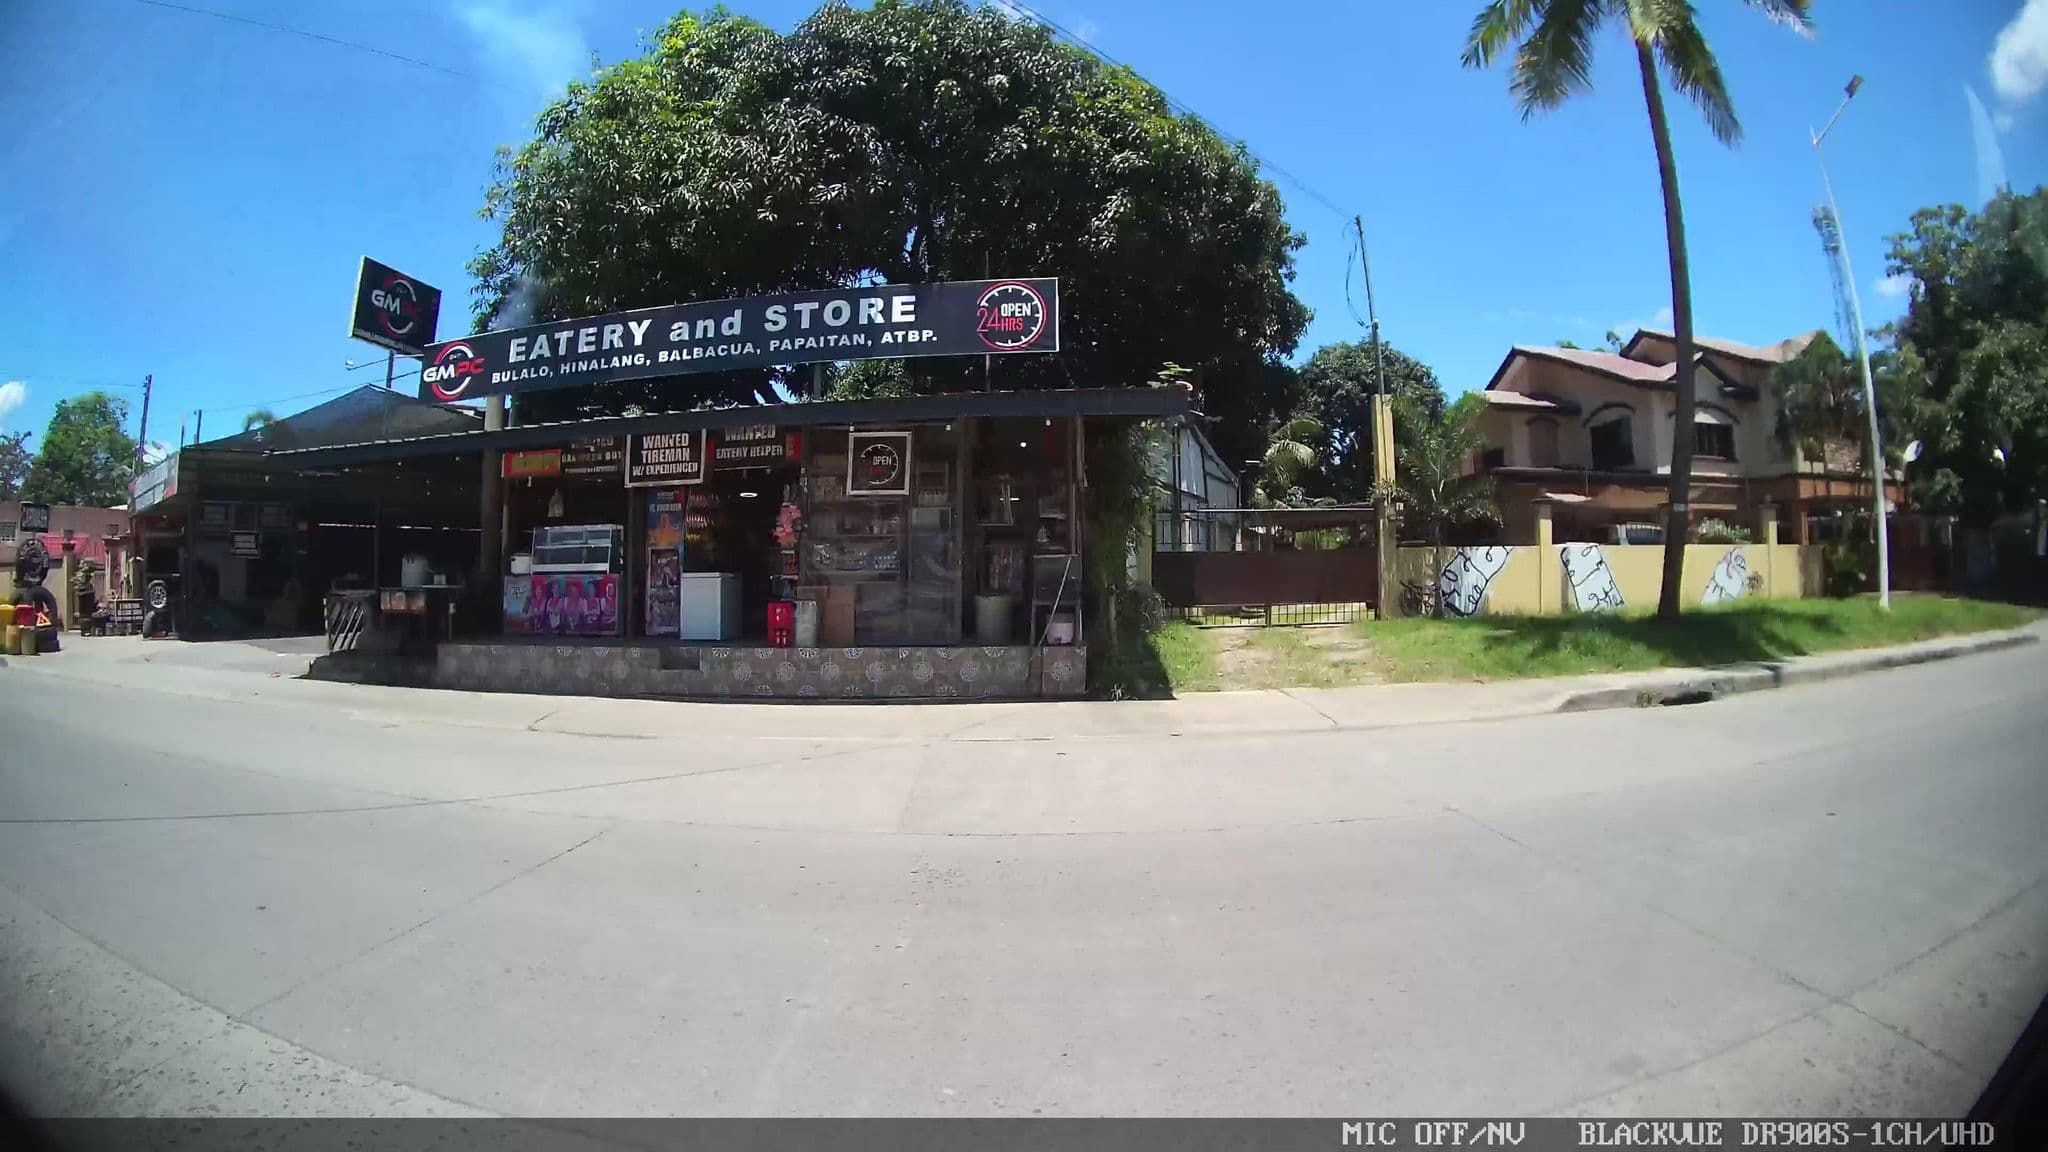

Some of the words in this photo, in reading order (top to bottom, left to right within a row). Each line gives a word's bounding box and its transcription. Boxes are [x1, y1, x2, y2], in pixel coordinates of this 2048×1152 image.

[1001, 302, 1032, 318] OPEN
[508, 319, 653, 362] EATERY
[669, 308, 743, 342] and
[764, 295, 917, 333] STORE
[491, 364, 554, 384] BULALO,
[560, 352, 652, 374] HINALANG,
[657, 342, 762, 363] BALBACUA,
[769, 333, 873, 353] PAPAITAN,
[880, 329, 938, 345] ATBP.
[423, 357, 485, 383] GMPC
[642, 432, 689, 449] WANTED
[640, 447, 690, 464] TIREMAN
[872, 455, 892, 466] OPEN
